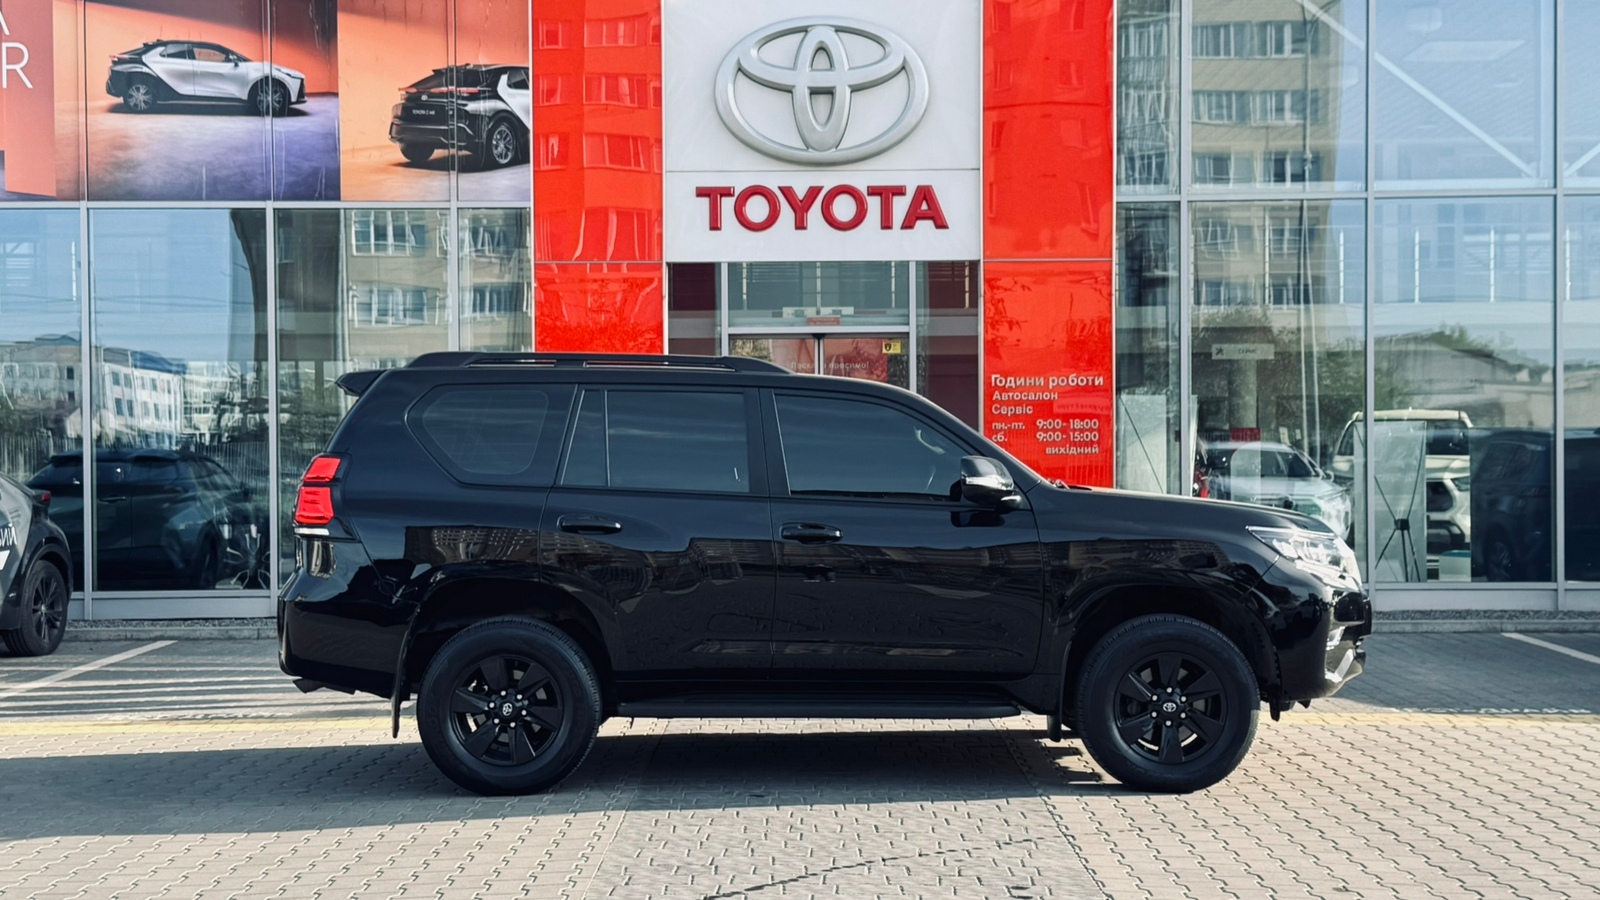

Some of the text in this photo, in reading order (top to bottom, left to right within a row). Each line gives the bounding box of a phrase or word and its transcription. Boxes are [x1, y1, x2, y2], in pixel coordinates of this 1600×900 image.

[695, 184, 950, 232] TOYOTA
[991, 373, 1104, 389] Години роботи
[992, 391, 1058, 401] Автосалон
[992, 404, 1033, 417] Сервіс
[992, 431, 1008, 442] сб.
[1045, 444, 1099, 455] вихідний
